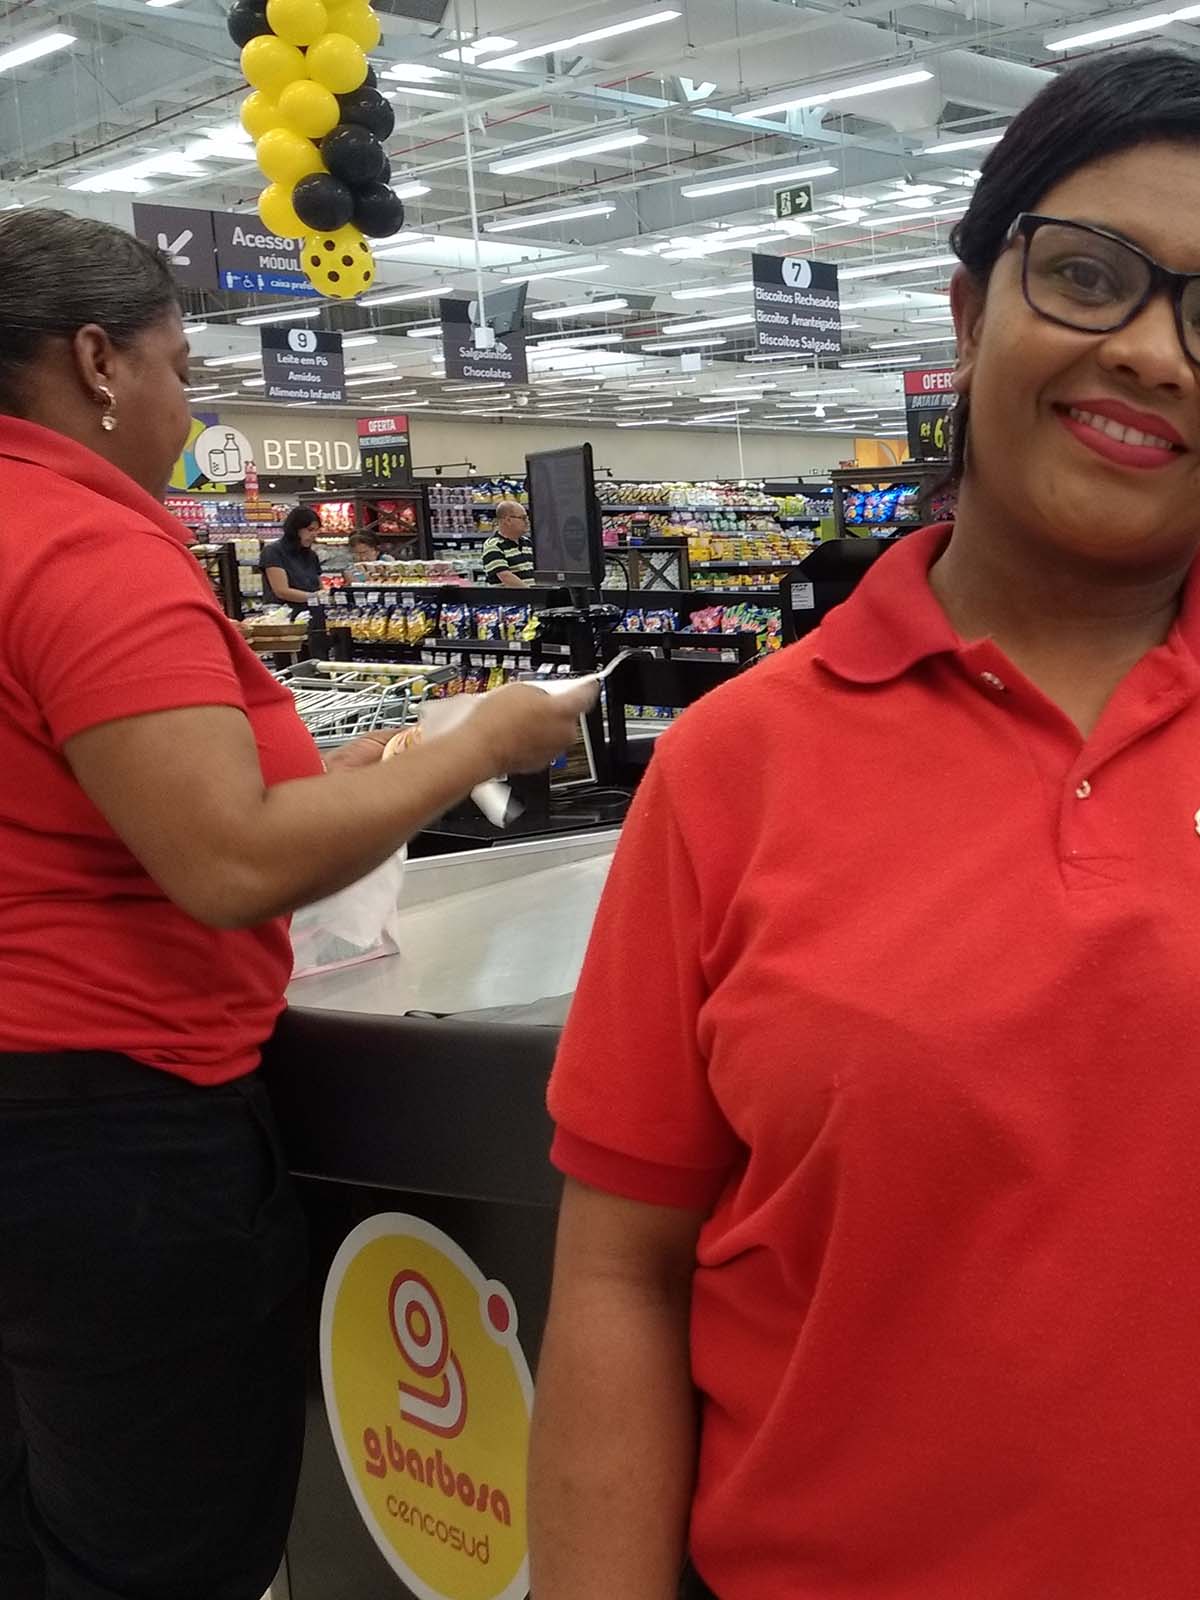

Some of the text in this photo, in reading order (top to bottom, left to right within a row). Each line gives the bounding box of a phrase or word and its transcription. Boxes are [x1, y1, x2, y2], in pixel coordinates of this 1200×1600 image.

[232, 226, 295, 251] Acesso
[259, 253, 303, 272] MÓDUL
[791, 262, 802, 282] 7
[756, 288, 840, 310] Biscoitos Recheados
[757, 310, 840, 332] Biscoitos Amanteigados
[297, 332, 308, 348] 9
[759, 332, 840, 352] Biscoitos Salgados
[277, 353, 299, 364] Leite
[300, 357, 315, 365] em
[459, 346, 512, 360] Salgadinhos
[288, 371, 321, 383] Amidos
[463, 365, 512, 379] Chocolates
[922, 372, 955, 390] OFER
[269, 386, 341, 400] Alimento Infantil
[368, 419, 397, 433] OFERTA
[363, 1424, 512, 1527] gbarbosa
[386, 1494, 491, 1566] cencosud
